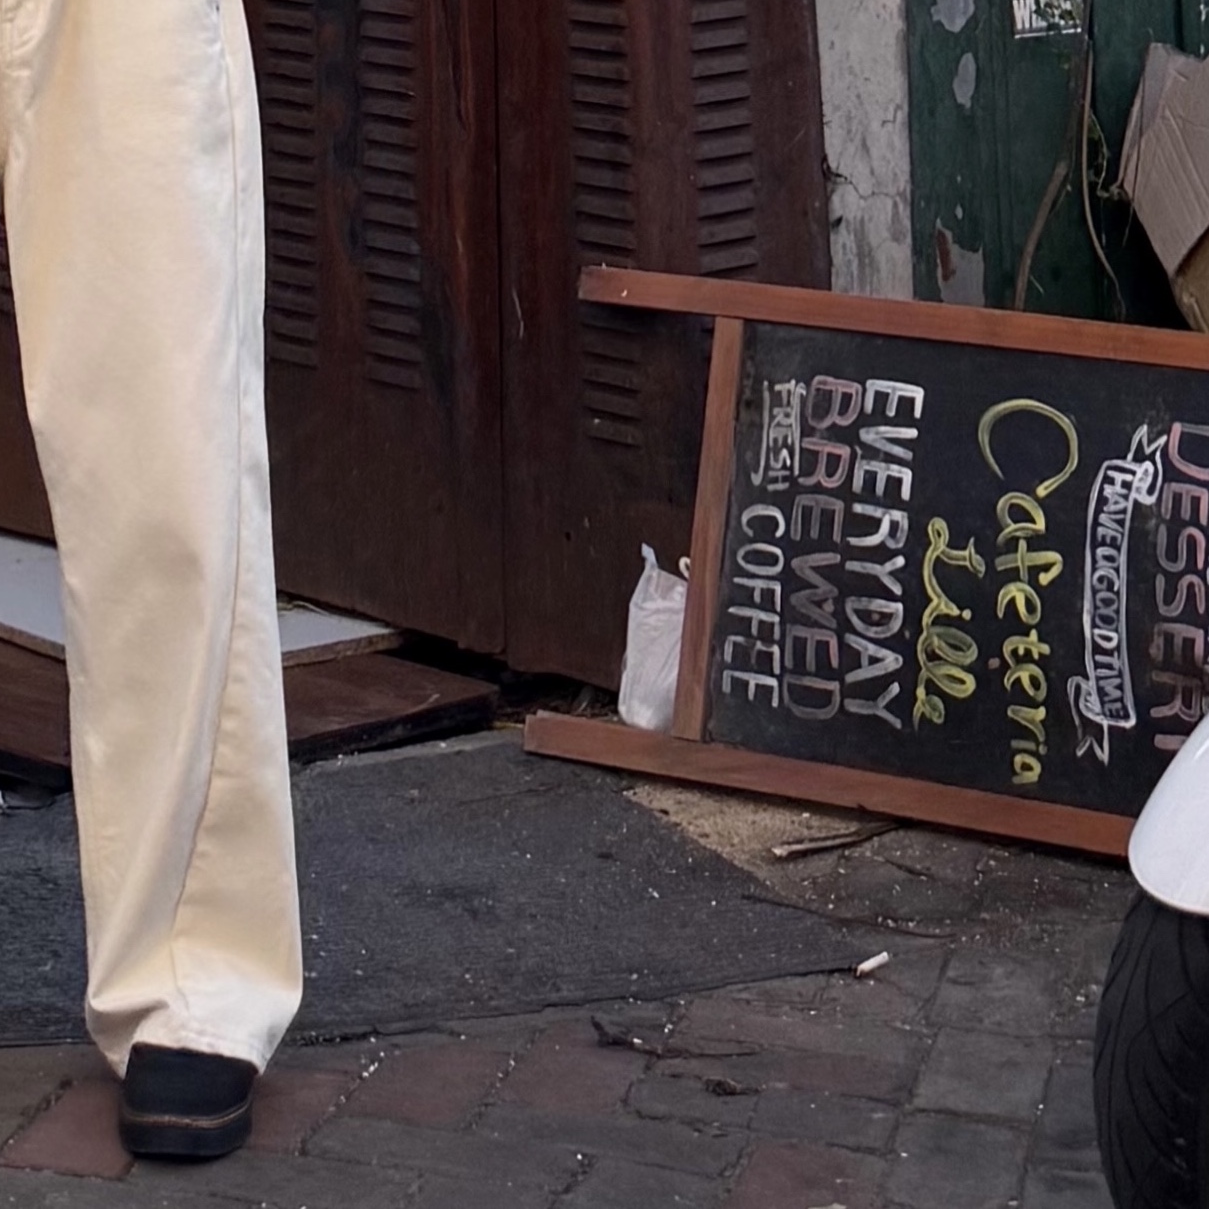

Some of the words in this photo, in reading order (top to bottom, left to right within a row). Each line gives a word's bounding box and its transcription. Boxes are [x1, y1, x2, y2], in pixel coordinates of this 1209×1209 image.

[767, 380, 794, 492] FRESH
[1096, 469, 1133, 547] HAVE
[722, 503, 785, 708] COFFEE
[783, 374, 863, 721] BREWED
[843, 378, 925, 730] EVERYDAY
[979, 398, 1079, 784] Cafeteria
[1093, 569, 1121, 650] GOOD
[1093, 653, 1124, 719] TIME
